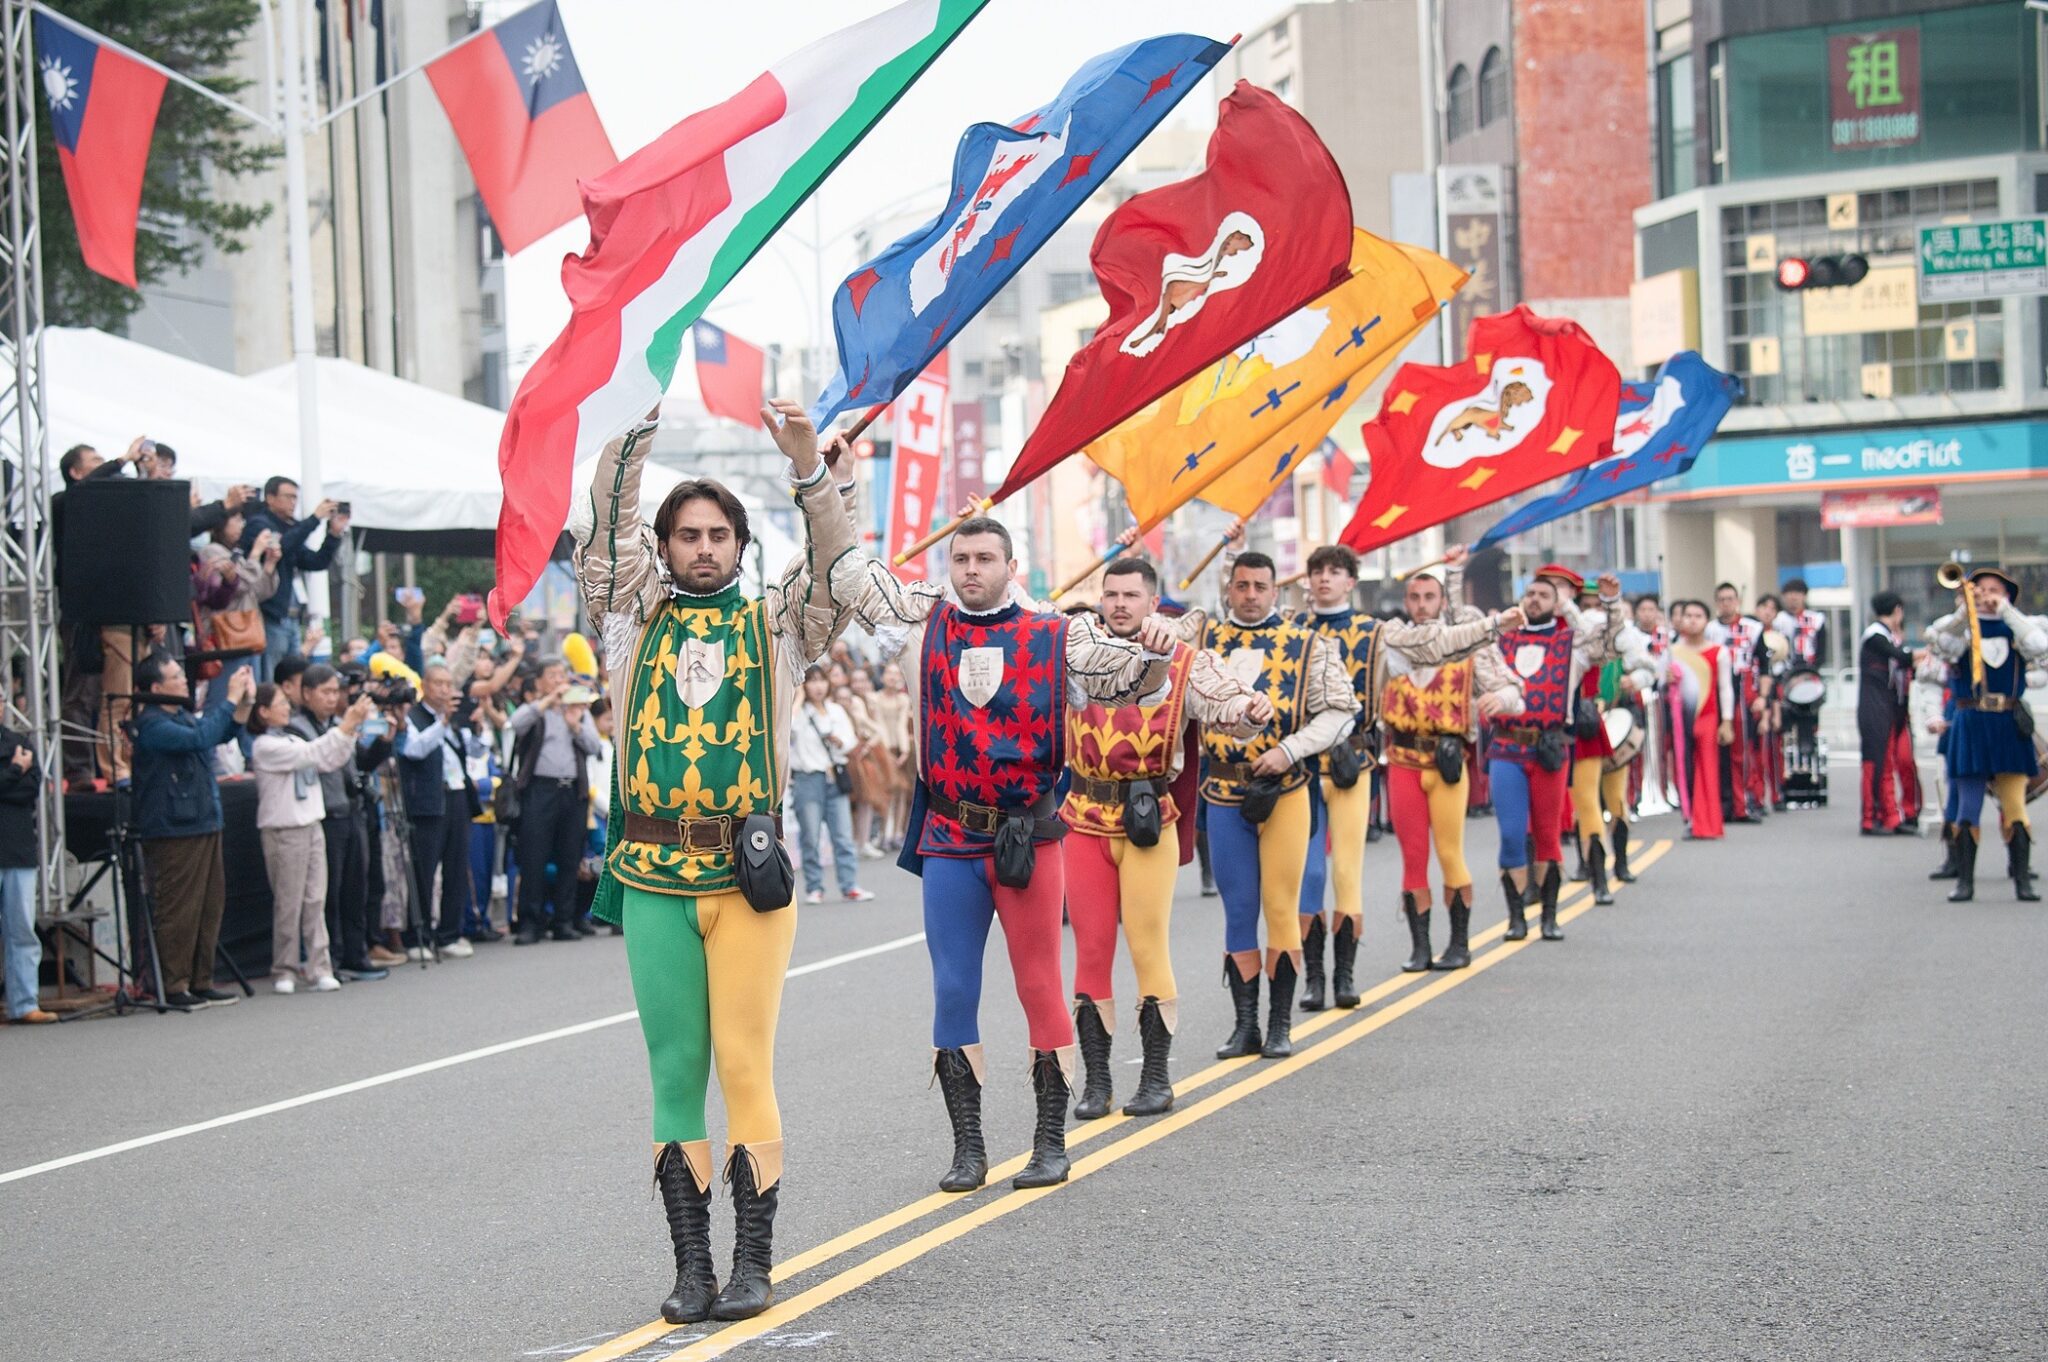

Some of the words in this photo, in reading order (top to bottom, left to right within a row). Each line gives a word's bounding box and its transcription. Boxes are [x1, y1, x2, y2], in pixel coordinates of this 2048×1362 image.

[1846, 42, 1904, 110] 租
[1931, 222, 2035, 254] 吳鳳北路
[1932, 253, 1993, 271] Wufeng
[1786, 442, 1852, 481] 杏一
